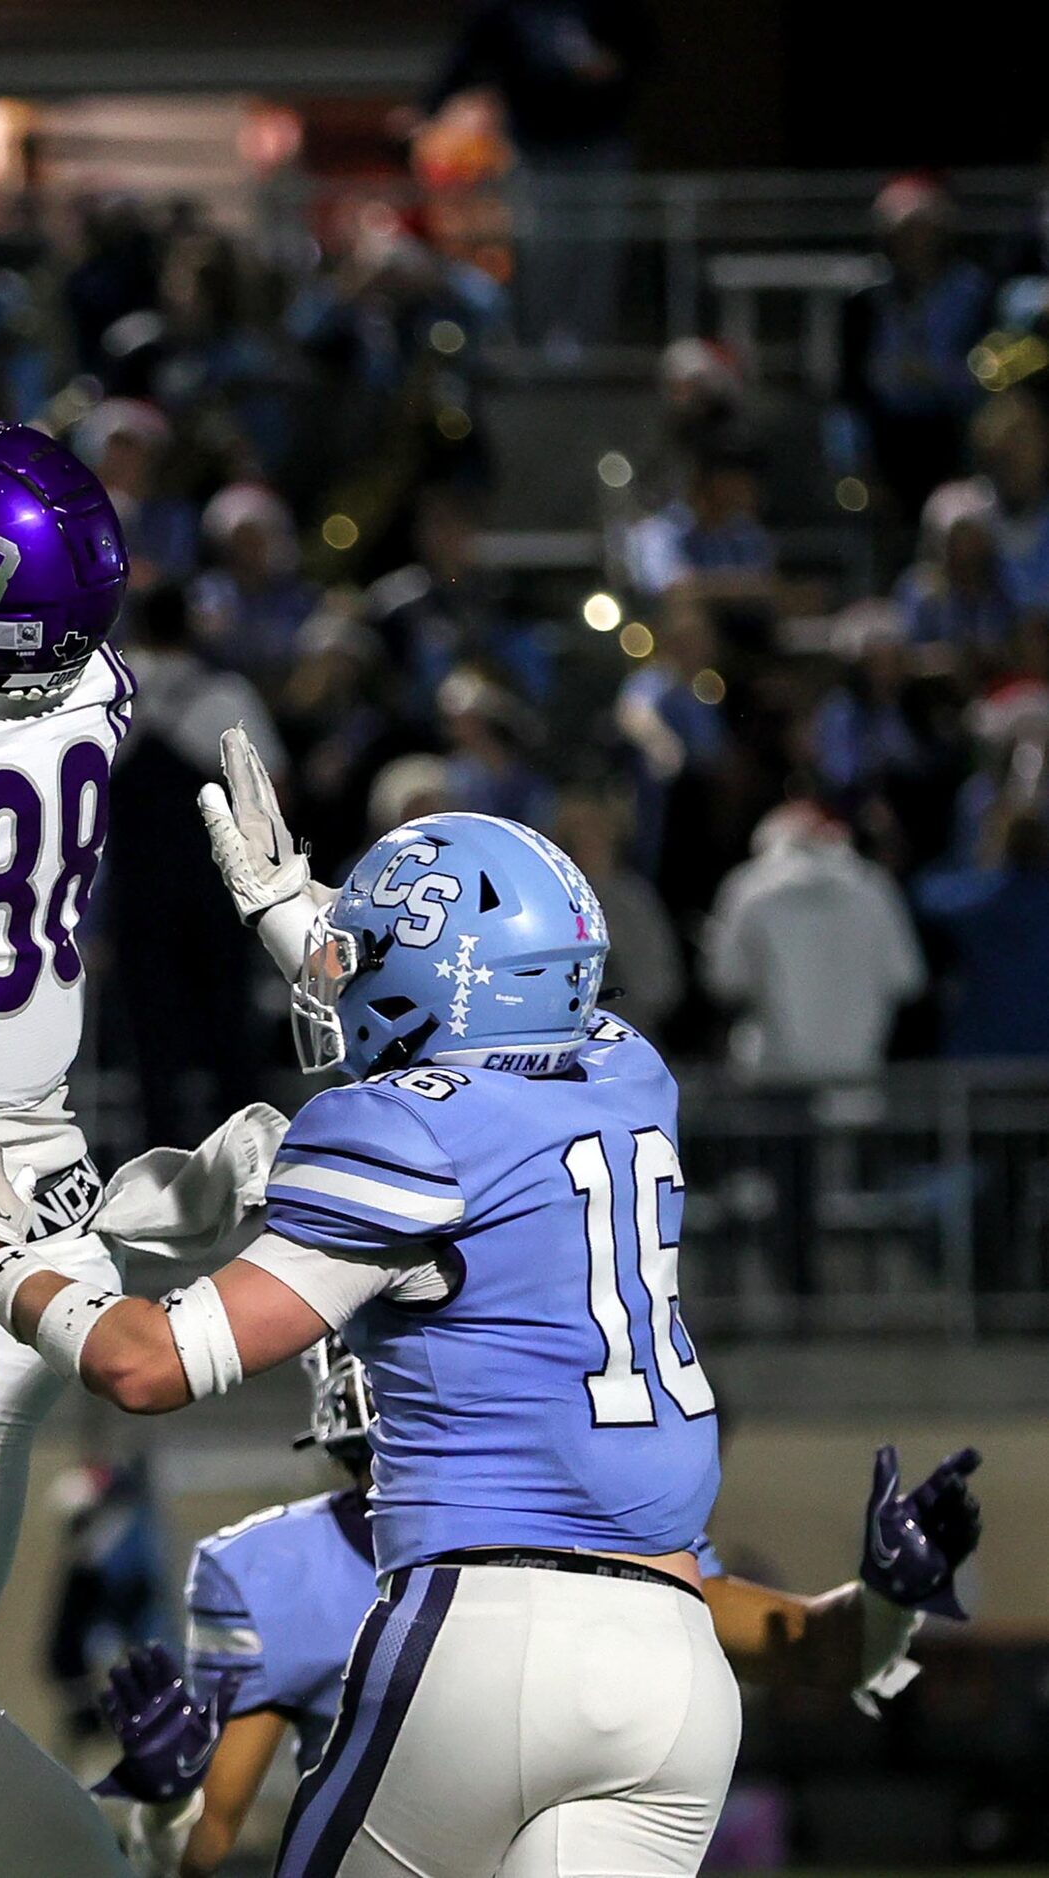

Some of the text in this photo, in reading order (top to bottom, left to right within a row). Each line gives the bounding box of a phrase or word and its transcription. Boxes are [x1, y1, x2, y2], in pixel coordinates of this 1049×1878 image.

[370, 842, 463, 949] CS
[481, 1053, 550, 1072] CHINA
[560, 1125, 716, 1429] 16
